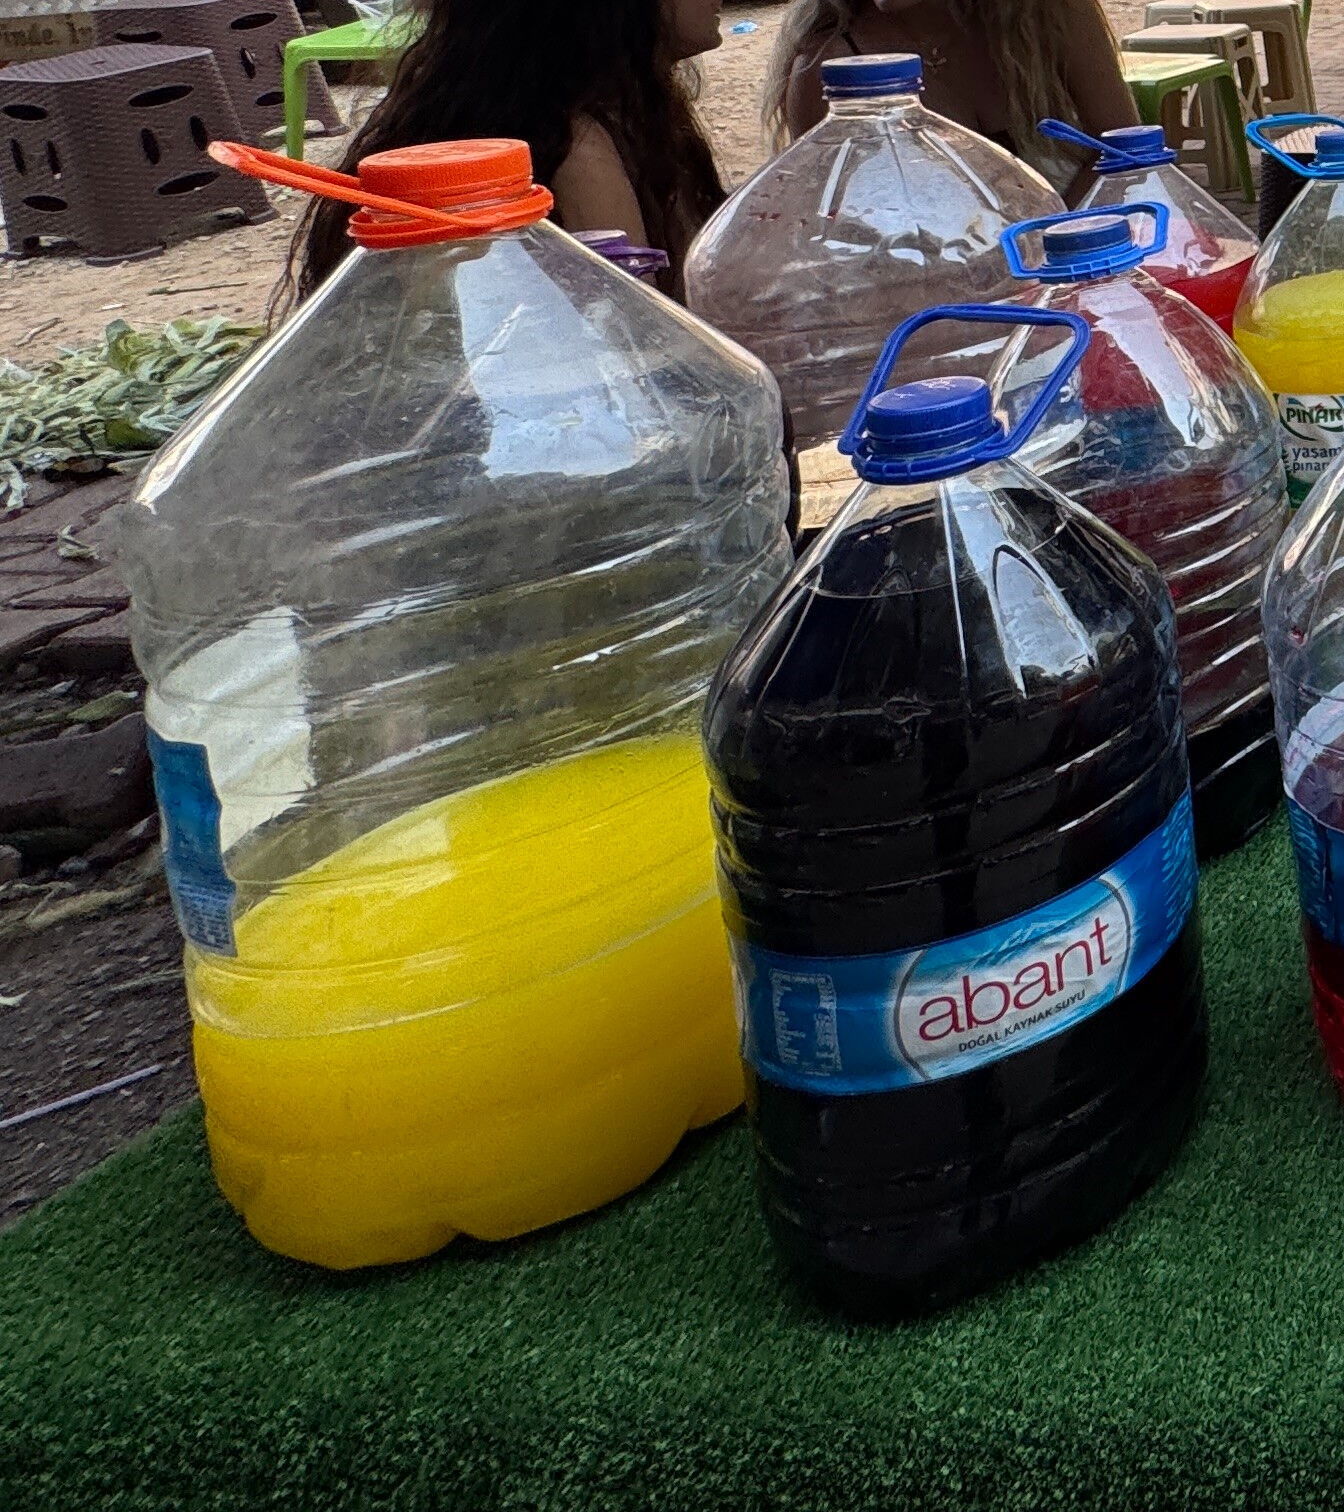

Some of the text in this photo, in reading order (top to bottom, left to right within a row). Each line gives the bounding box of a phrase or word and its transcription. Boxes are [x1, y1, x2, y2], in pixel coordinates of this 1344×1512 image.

[1286, 405, 1343, 424] PINAR
[919, 917, 1112, 1041] abant
[959, 989, 1087, 1052] DOĞAL KAYNAK SUYU
